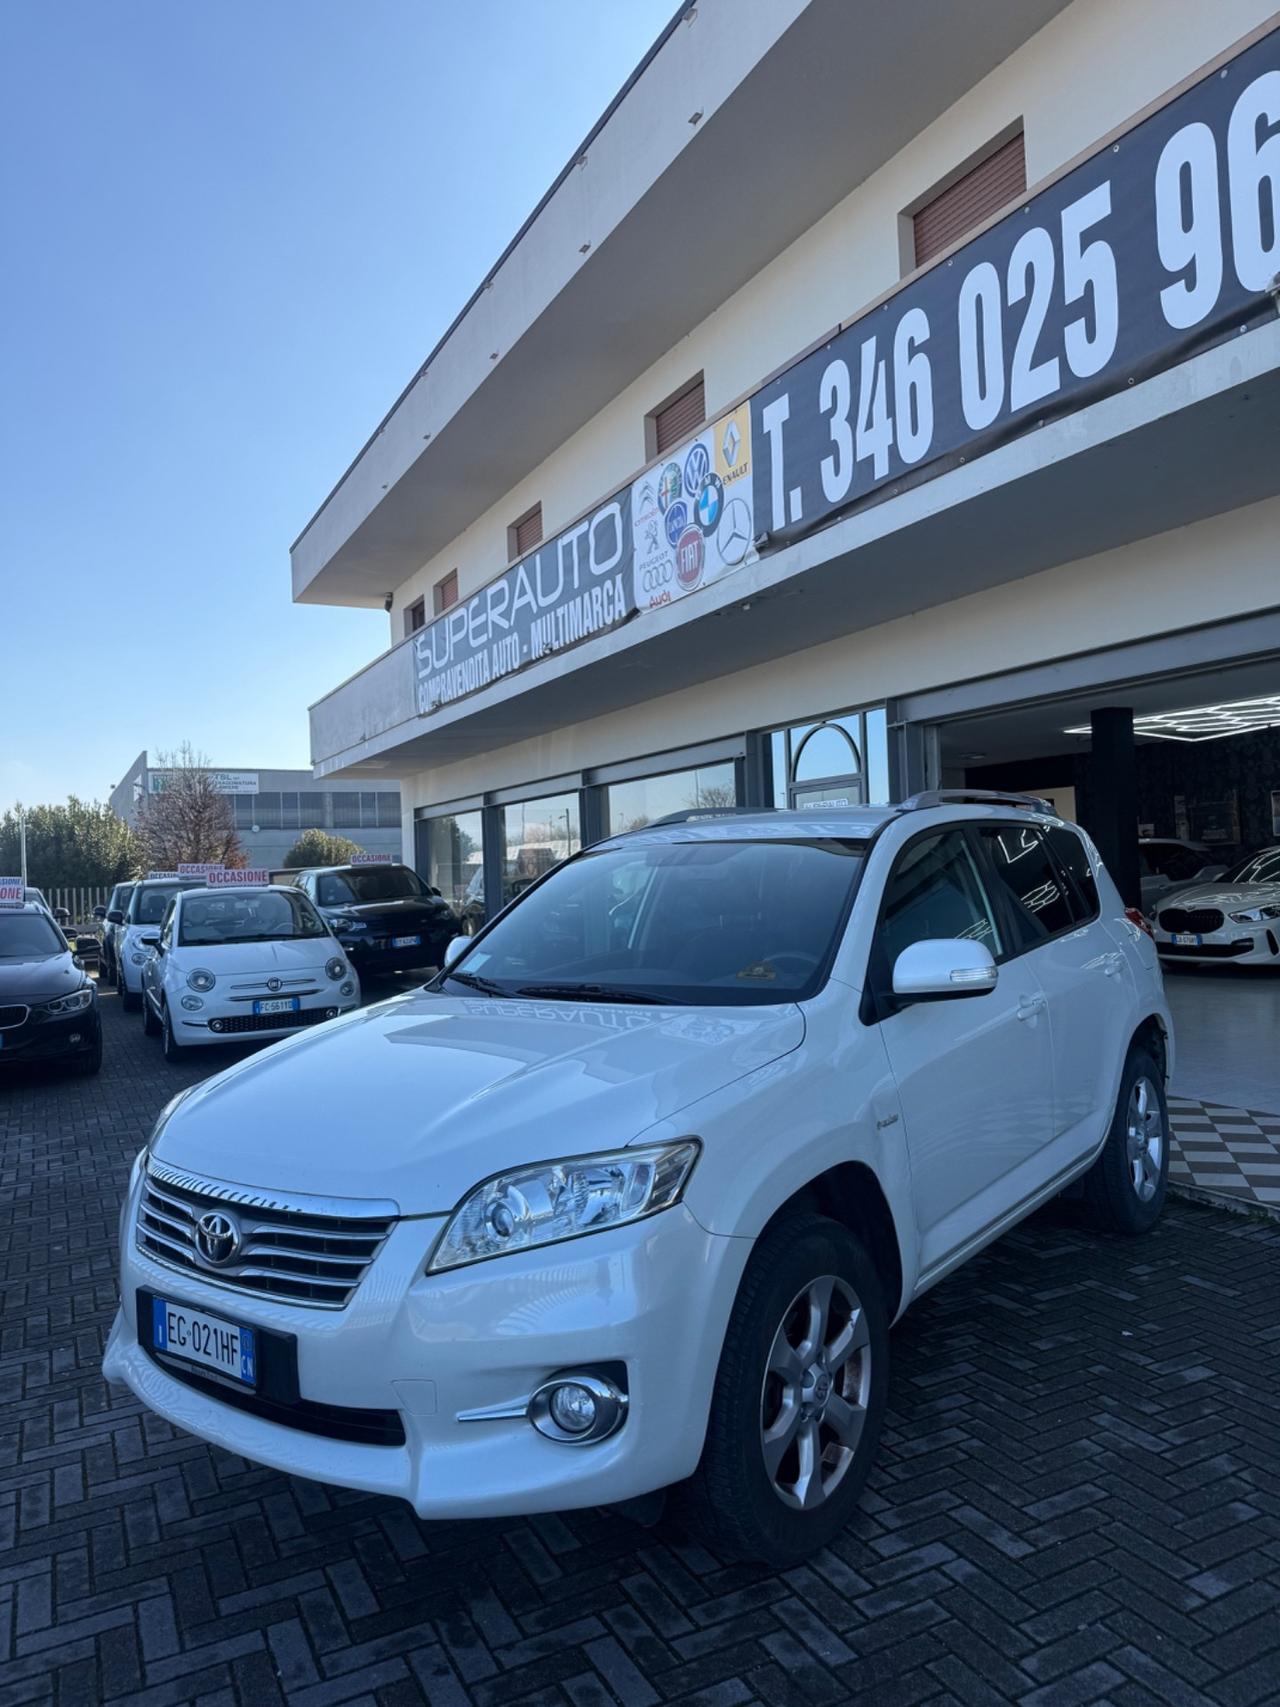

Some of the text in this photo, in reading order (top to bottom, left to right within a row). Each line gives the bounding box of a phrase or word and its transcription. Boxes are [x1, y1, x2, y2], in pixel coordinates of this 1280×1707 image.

[763, 393, 802, 532] T.
[820, 307, 934, 504] 346
[958, 180, 1118, 431] 025
[722, 462, 748, 486] ENAULT
[416, 502, 623, 679] SUPERAUTO
[681, 541, 699, 574] FIAT
[418, 649, 490, 714] COMPRAVENDITA
[492, 632, 520, 679] AUTO
[530, 573, 626, 660] MULTIMARCA
[209, 870, 267, 883] OCCASIONE
